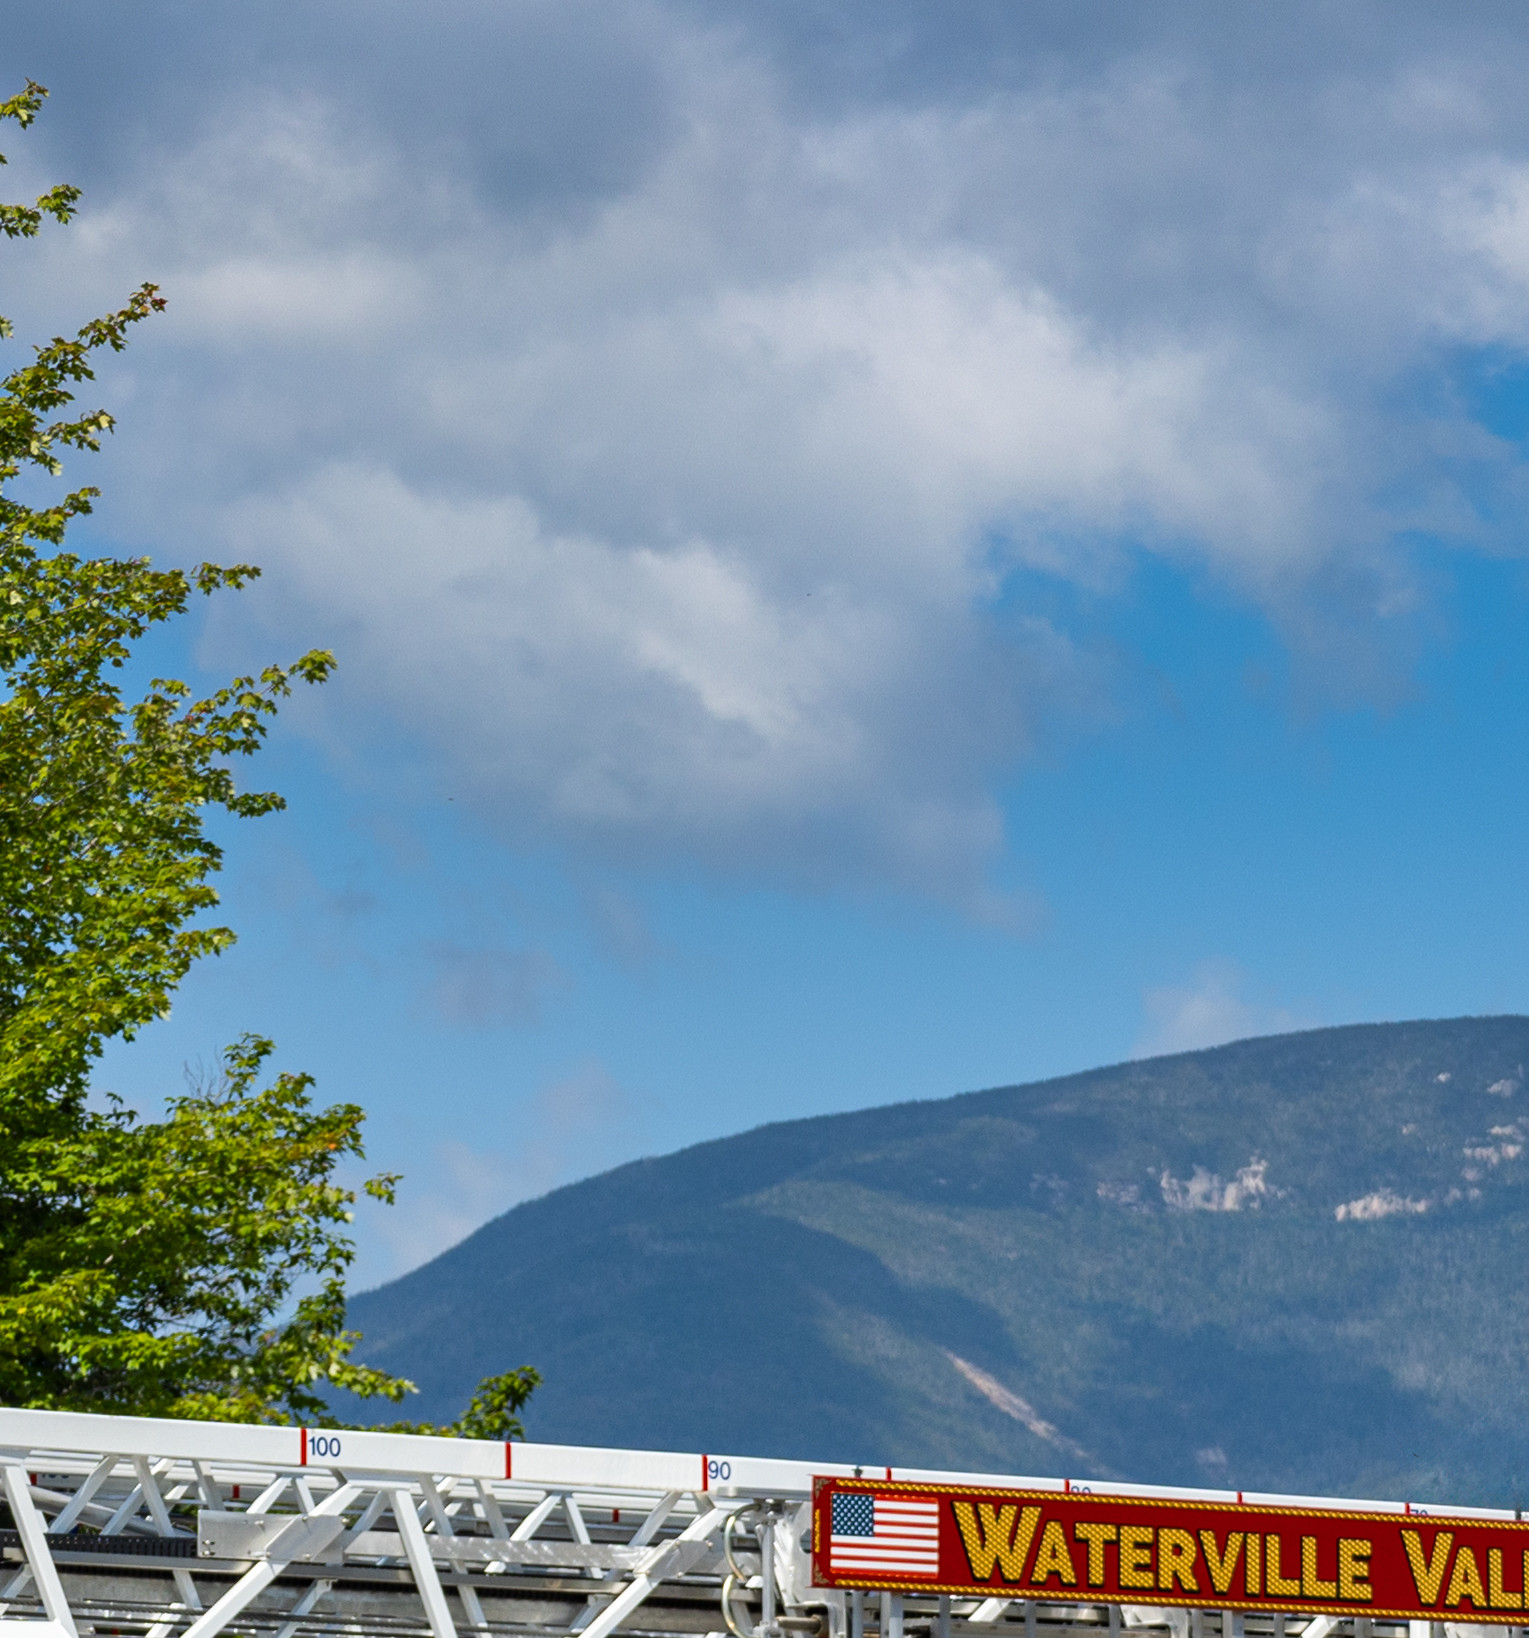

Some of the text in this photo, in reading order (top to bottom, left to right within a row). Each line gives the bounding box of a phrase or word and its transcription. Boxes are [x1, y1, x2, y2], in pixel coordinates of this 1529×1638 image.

[308, 1437, 341, 1457] 100
[708, 1460, 731, 1480] 90
[951, 1501, 1373, 1601] WATERVILLE
